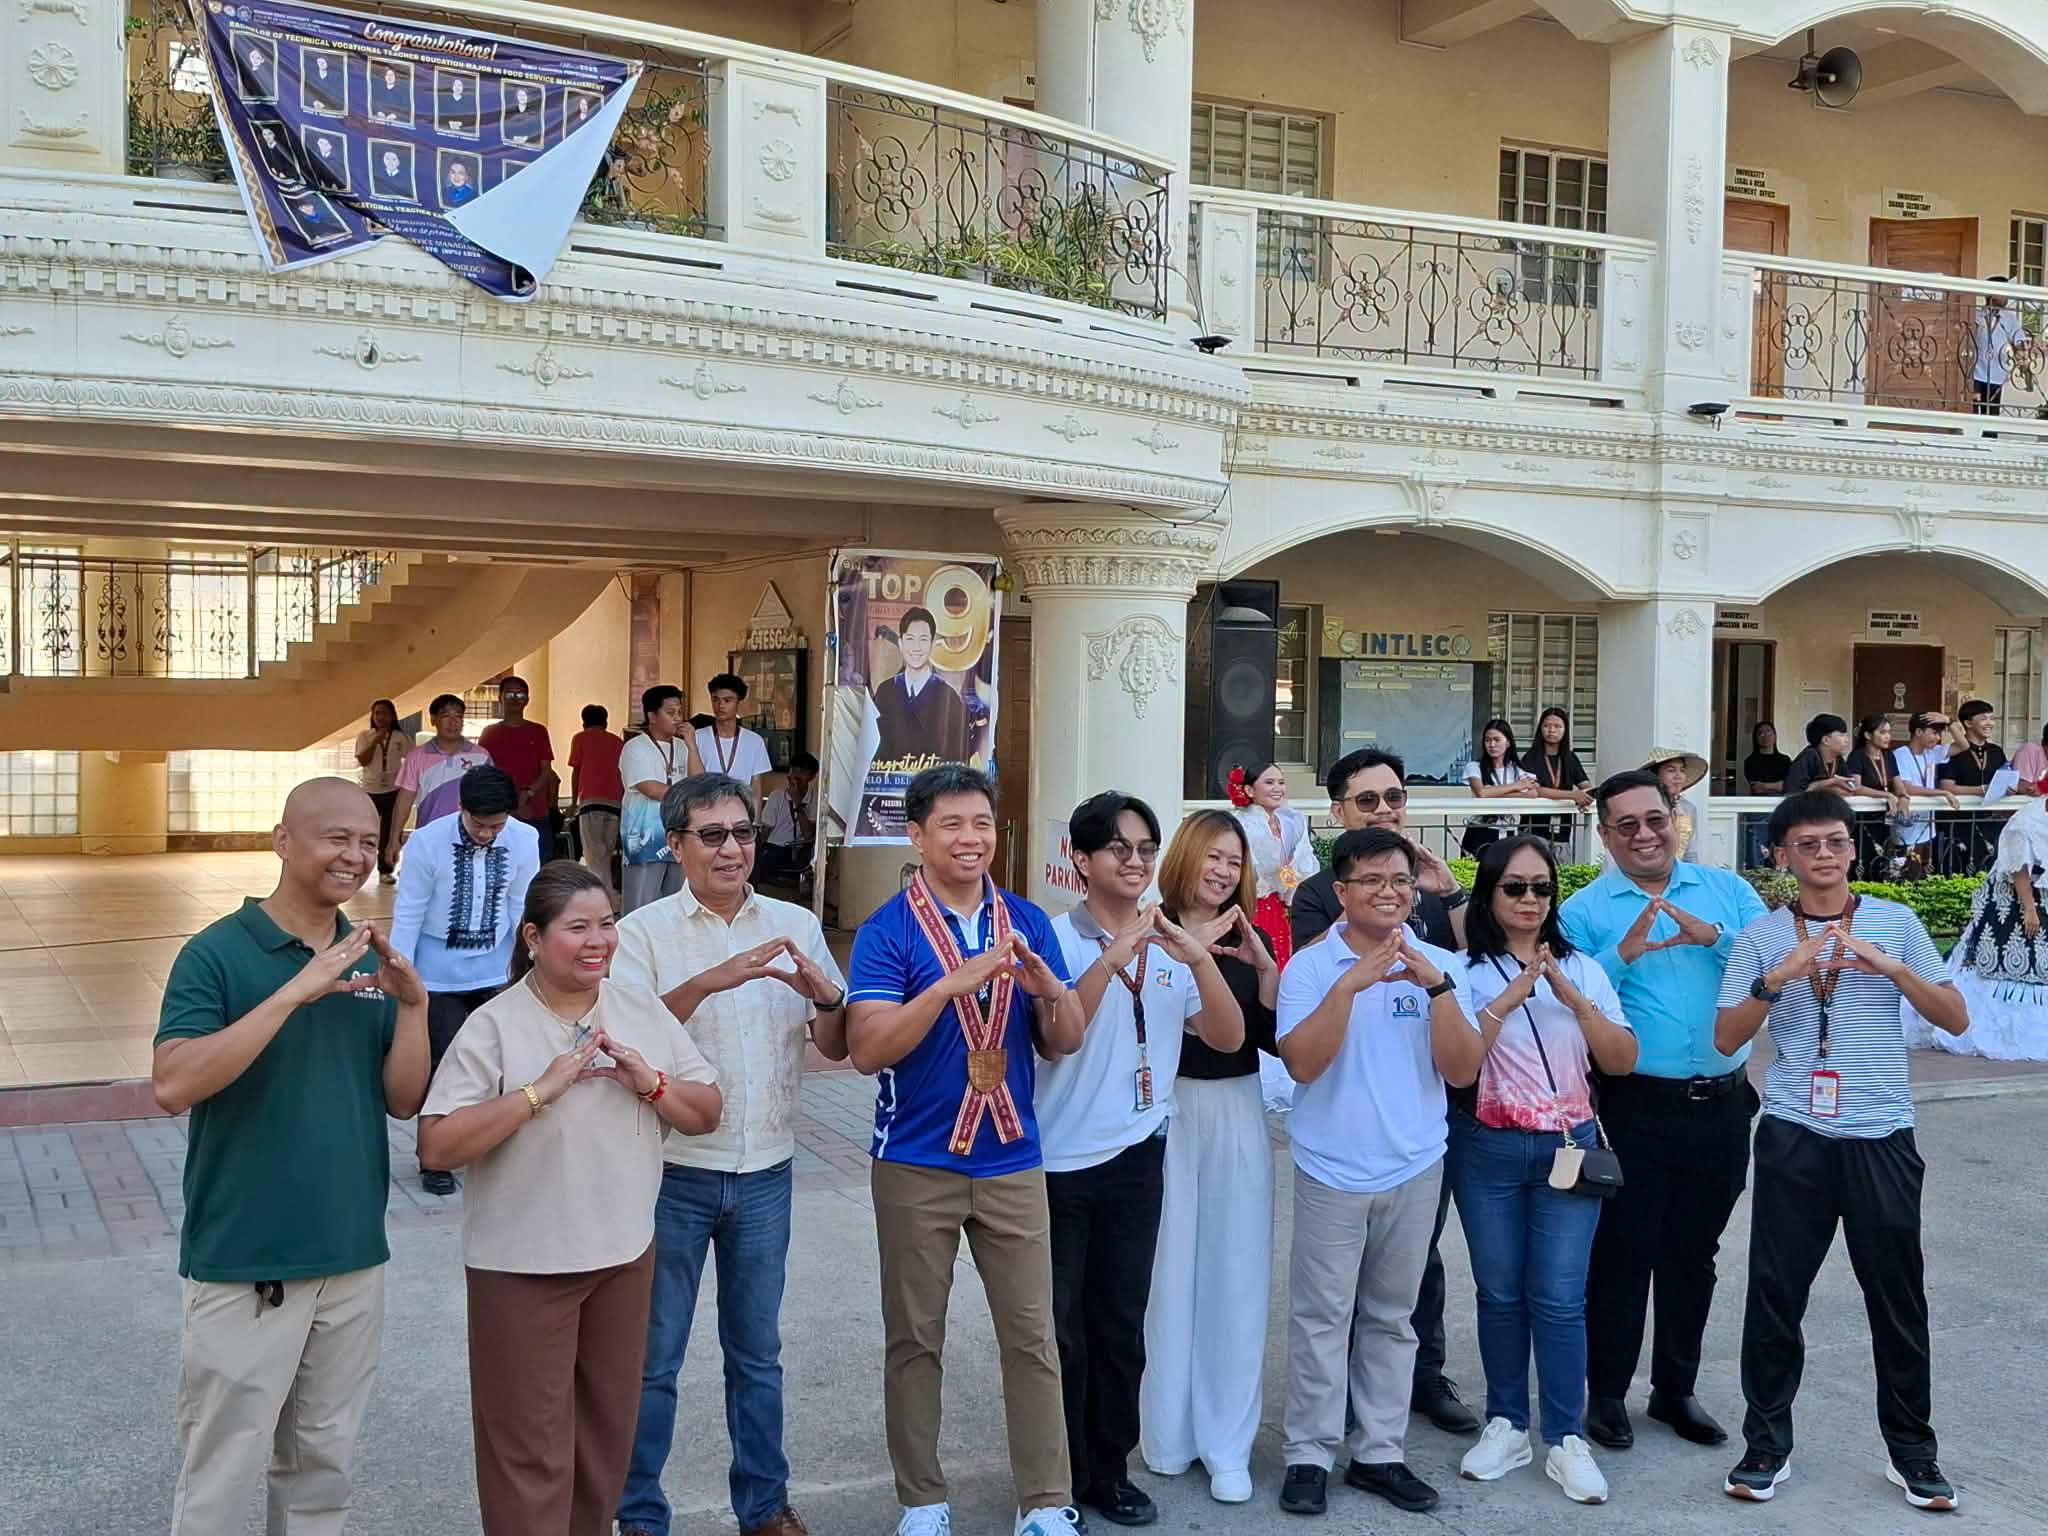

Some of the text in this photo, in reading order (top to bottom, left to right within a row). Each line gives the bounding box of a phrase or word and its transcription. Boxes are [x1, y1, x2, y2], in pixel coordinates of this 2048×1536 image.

[273, 32, 283, 40] OF
[285, 34, 330, 47] TECHNICAL
[332, 41, 382, 55] VOCATIONAL
[384, 49, 419, 60] TEACHER
[421, 55, 464, 68] EDUCATION
[466, 63, 492, 73] MAJOR
[503, 68, 523, 78] FOOD
[525, 72, 555, 84] SERVICE
[556, 78, 605, 92] MANAGEMENT
[1735, 168, 1765, 178] UNIVERSITY
[863, 564, 991, 673] TOP 9
